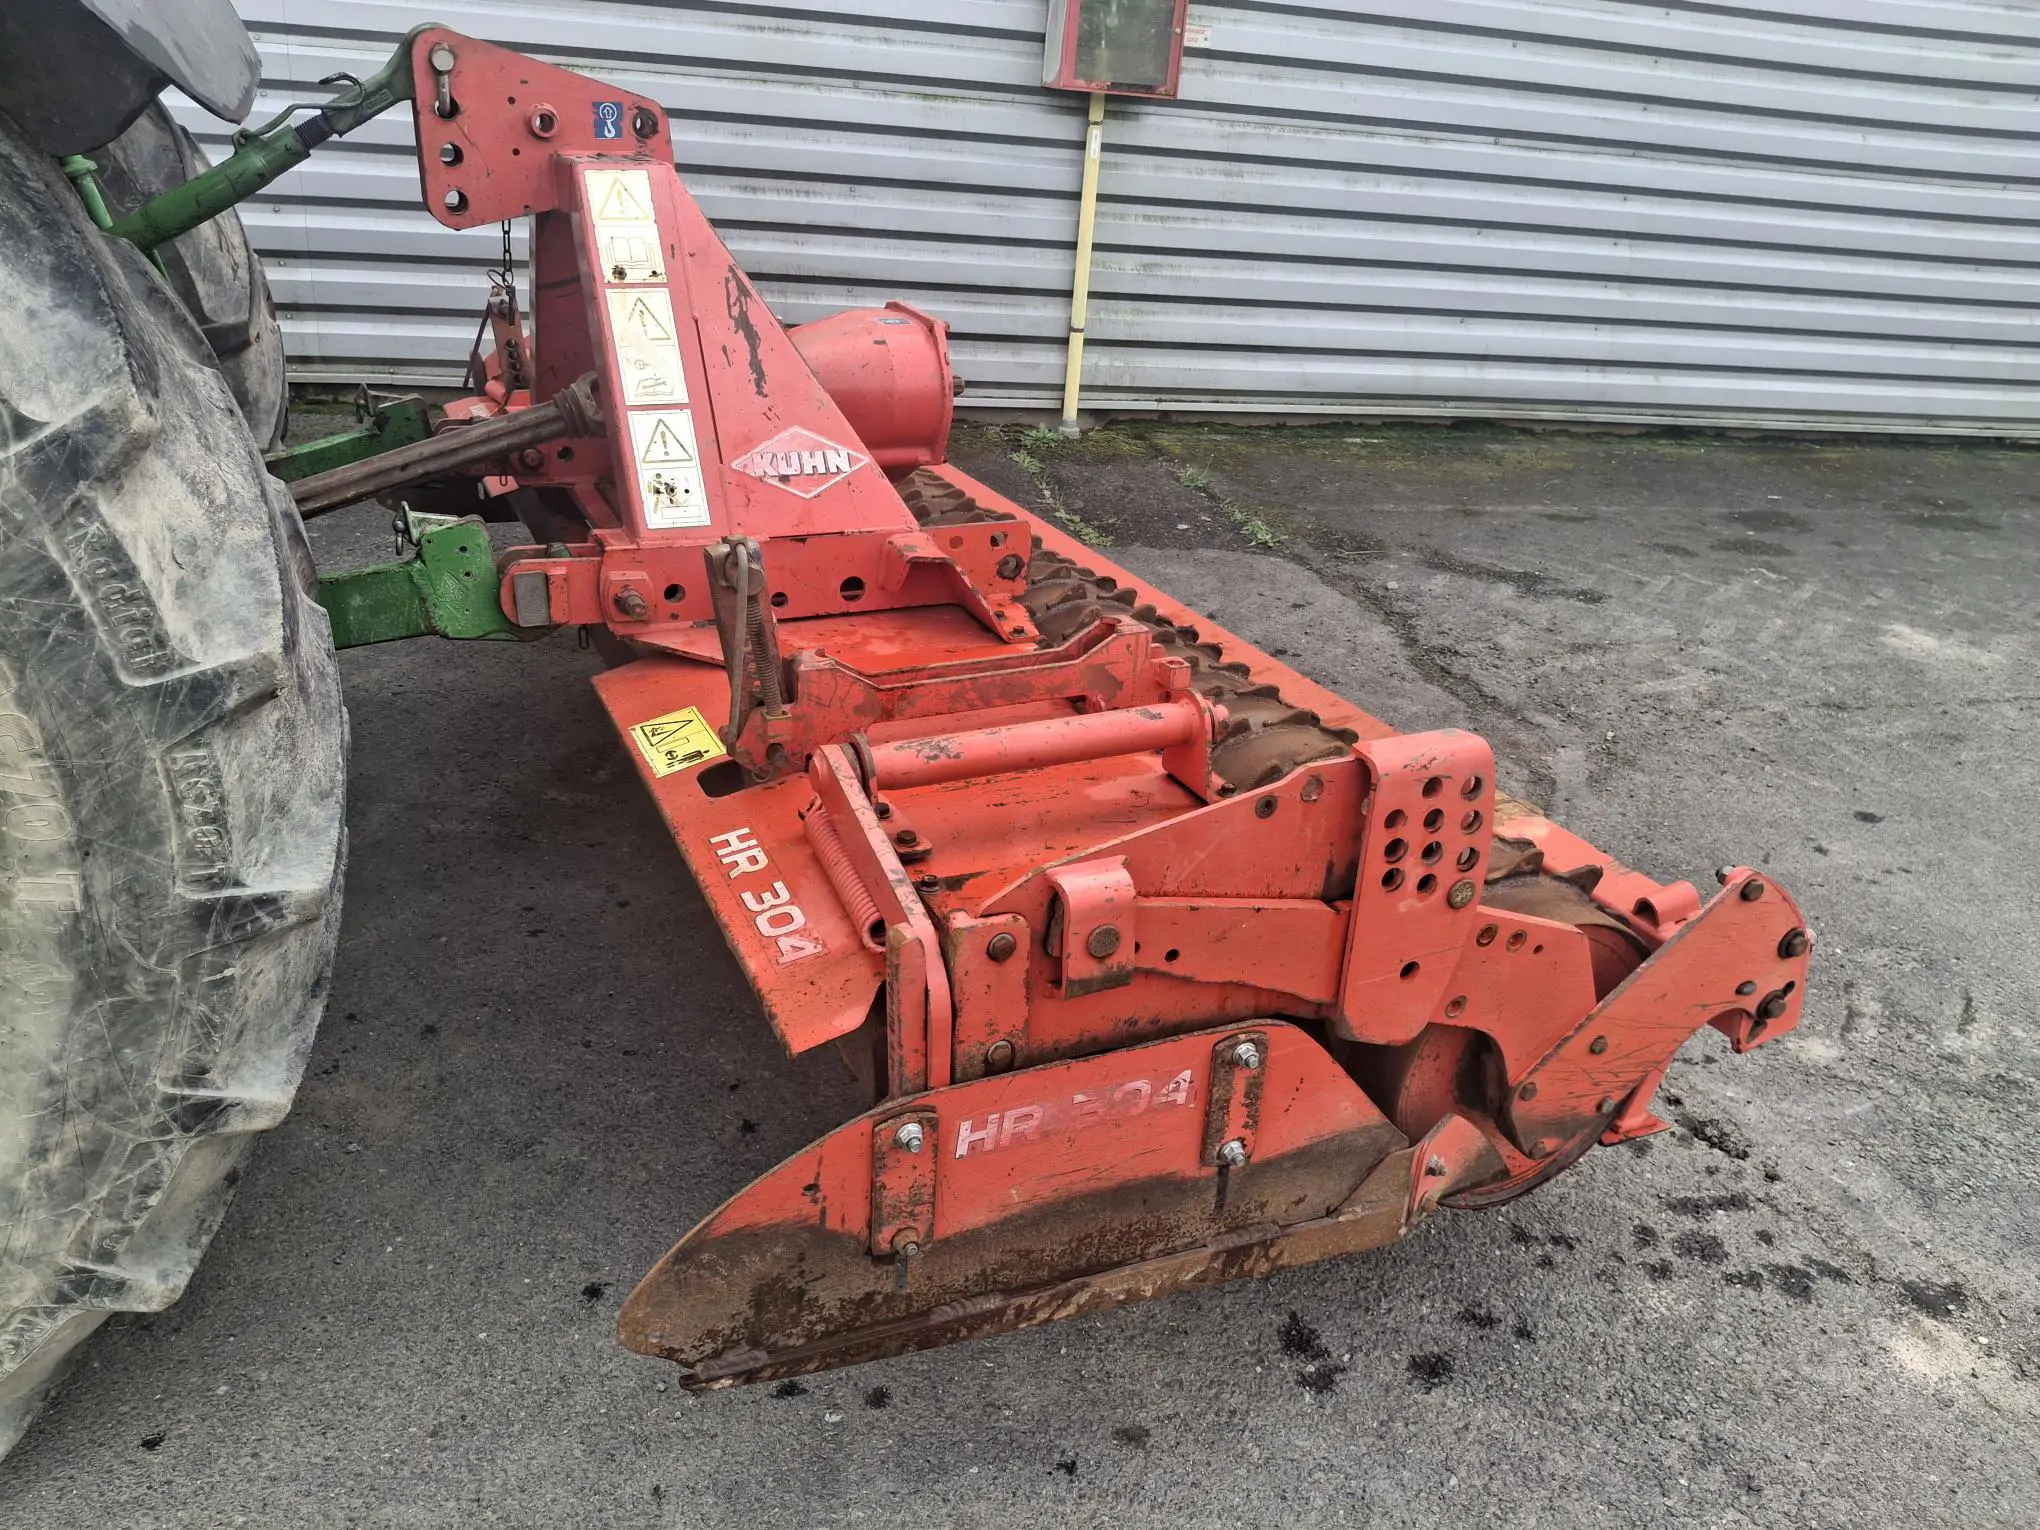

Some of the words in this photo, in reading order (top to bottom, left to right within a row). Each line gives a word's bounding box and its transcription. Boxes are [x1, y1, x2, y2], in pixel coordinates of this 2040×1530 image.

[751, 450, 851, 476] KUHN
[709, 827, 769, 879] HR
[739, 880, 824, 965] 304
[954, 1105, 1044, 1159] HR
